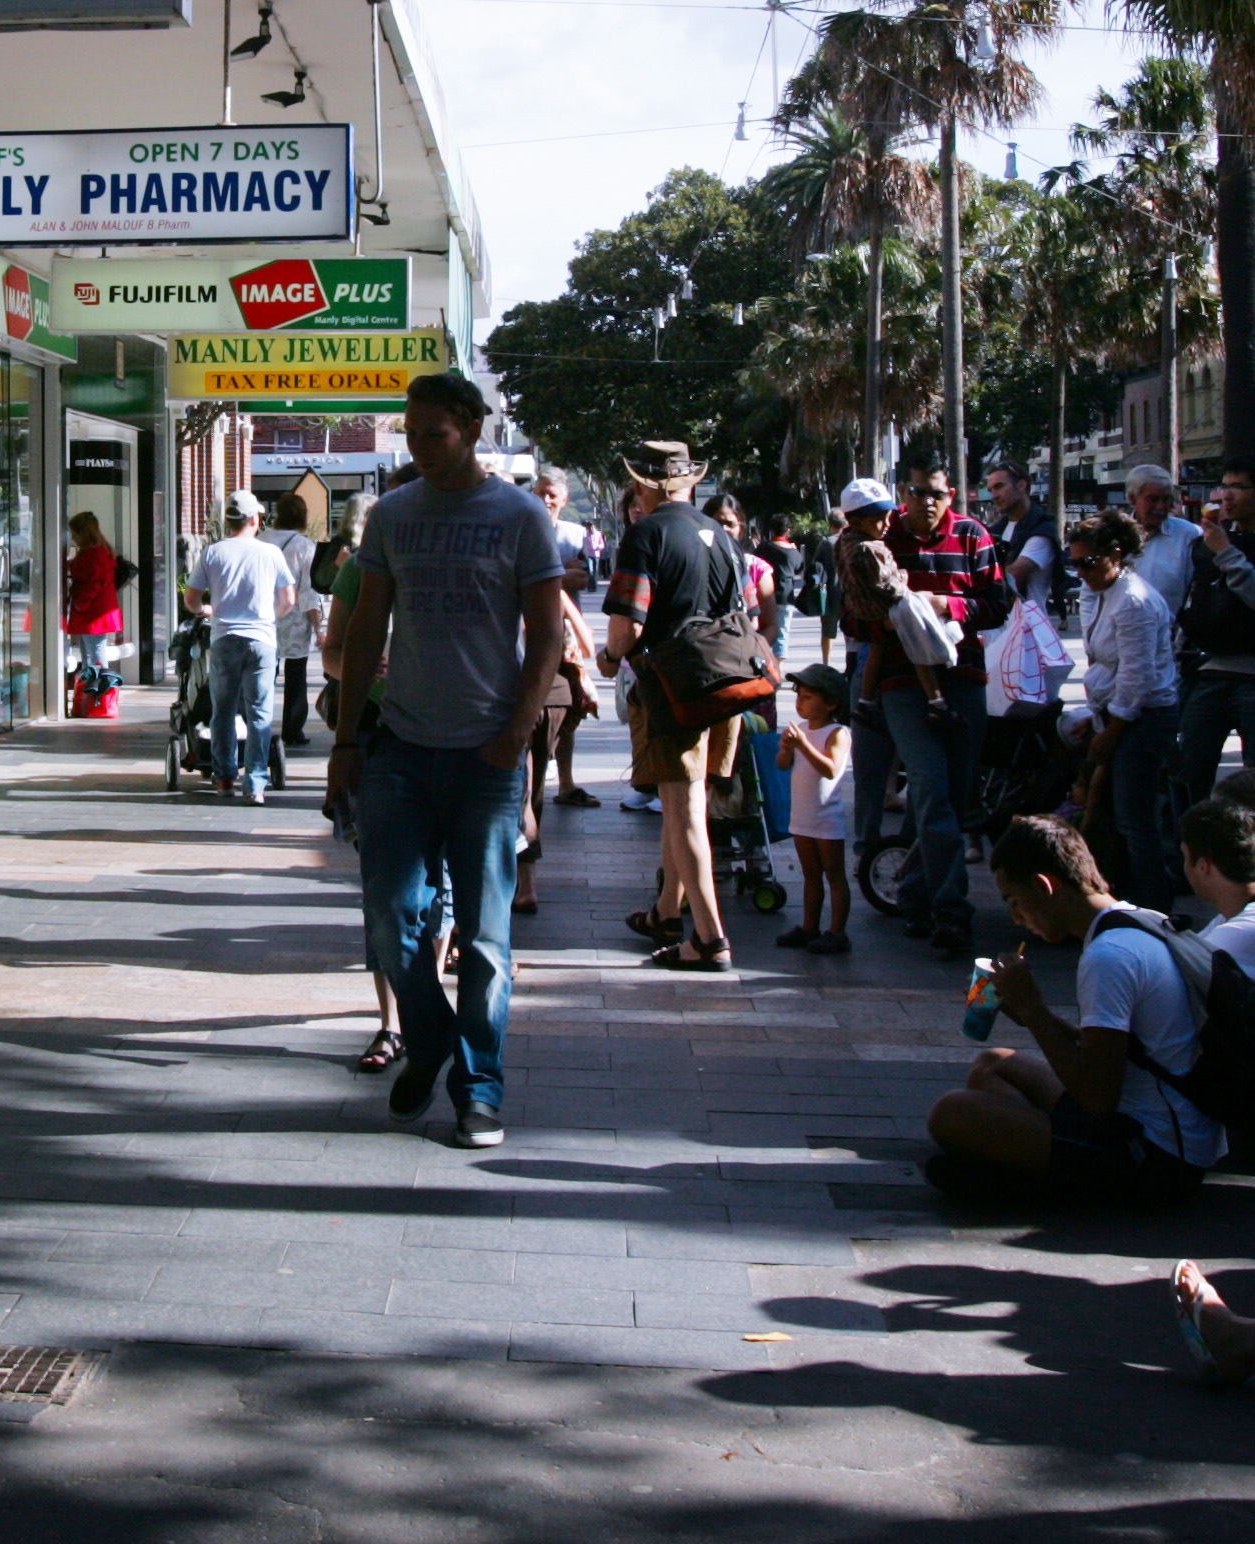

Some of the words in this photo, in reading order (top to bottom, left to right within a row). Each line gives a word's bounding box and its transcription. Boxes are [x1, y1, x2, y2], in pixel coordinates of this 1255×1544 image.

[129, 142, 200, 164] OPEN
[210, 142, 224, 161] 7
[232, 140, 301, 161] DAYS
[80, 169, 332, 215] PHARMACY
[30, 220, 56, 232] ALAN
[59, 221, 66, 231] &
[70, 220, 99, 231] JOHN
[102, 219, 145, 231] MALOUF
[5, 284, 30, 321] IMAGE
[108, 285, 218, 304] FUJIFILM
[240, 283, 316, 303] IMAGE
[332, 283, 393, 303] PLUS
[314, 315, 340, 326] Manly
[342, 315, 369, 326] Digital
[371, 315, 400, 324] Centre
[174, 338, 275, 364] MANLY
[282, 337, 440, 363] JEWELLER
[212, 374, 256, 390] TAX
[263, 373, 321, 390] FREE
[327, 373, 402, 389] OPALS
[394, 521, 505, 559] HILFIGER
